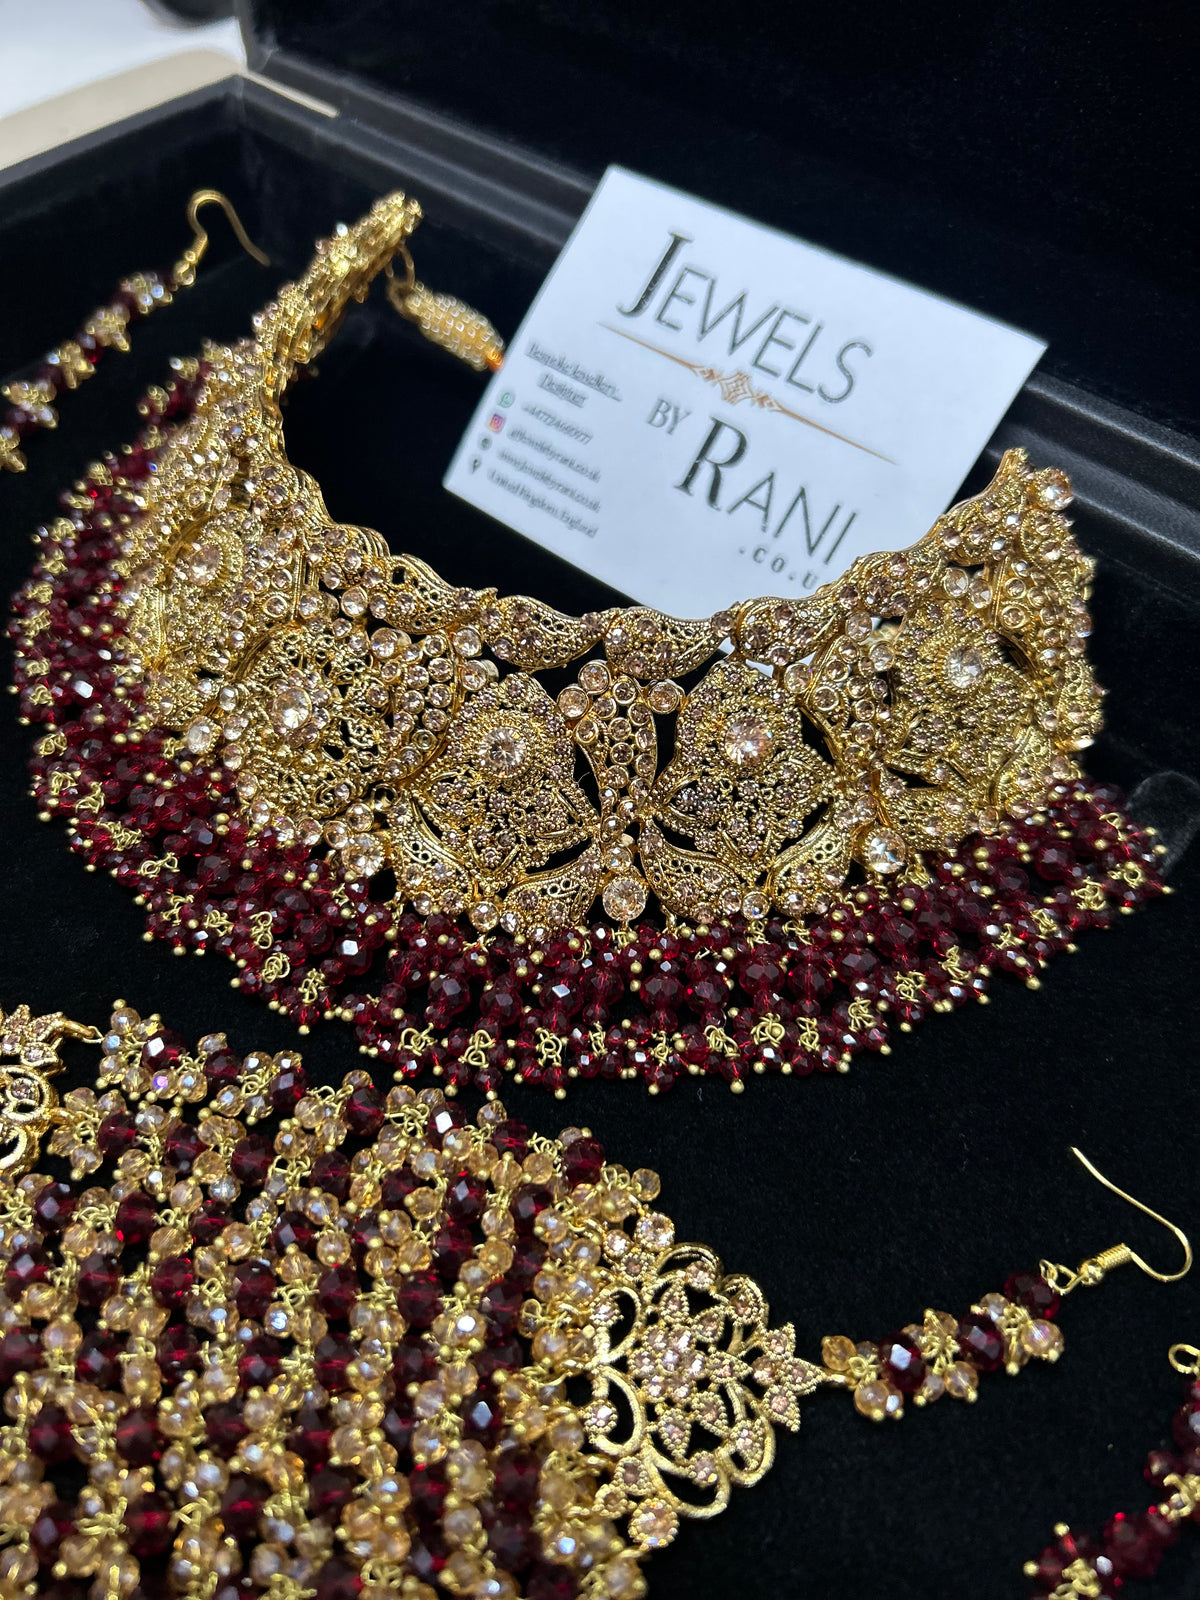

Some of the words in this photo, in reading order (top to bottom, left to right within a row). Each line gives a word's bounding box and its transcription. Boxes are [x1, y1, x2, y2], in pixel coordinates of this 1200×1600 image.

[615, 231, 874, 404] JEWELS
[647, 398, 691, 436] BY
[673, 416, 858, 566] RANI
